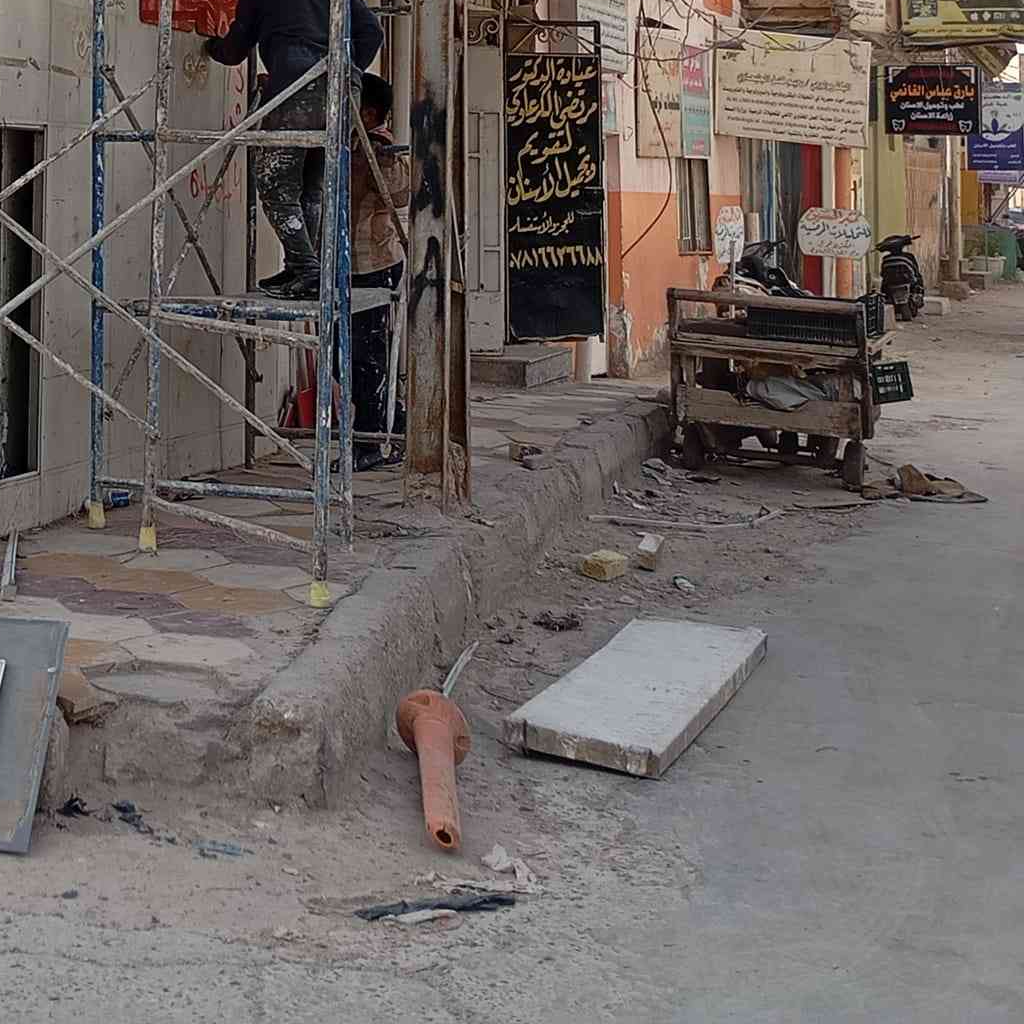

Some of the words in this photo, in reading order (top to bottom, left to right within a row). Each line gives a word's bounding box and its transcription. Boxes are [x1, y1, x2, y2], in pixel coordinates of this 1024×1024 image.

[509, 55, 556, 86] الدكتور
[556, 56, 598, 87] عيادة
[550, 84, 598, 129] مرتضى
[517, 122, 573, 172] لتقويم
[555, 145, 597, 198] وتجميل
